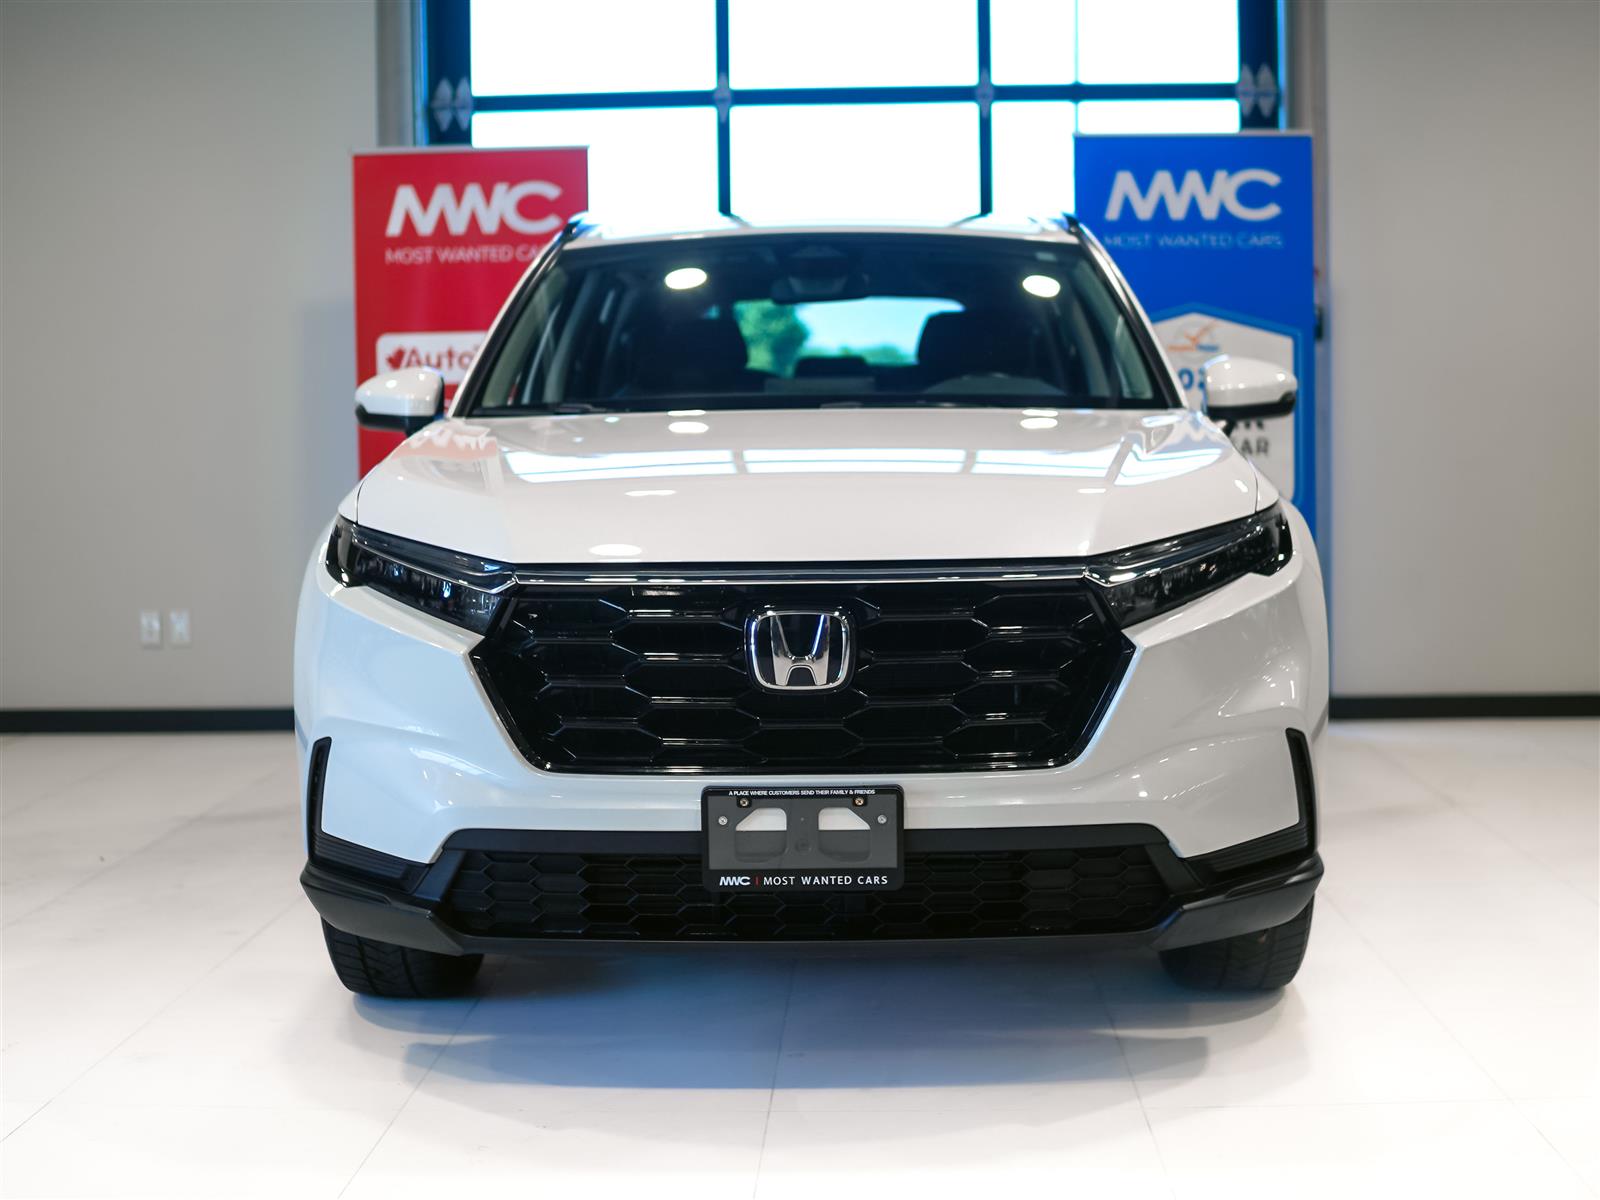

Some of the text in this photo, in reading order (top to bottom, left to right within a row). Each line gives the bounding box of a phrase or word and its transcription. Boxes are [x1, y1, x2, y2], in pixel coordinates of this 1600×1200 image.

[1105, 168, 1282, 222] MWC
[384, 180, 563, 238] MWC
[1104, 231, 1283, 249] MOST WANTED CARS
[384, 243, 544, 265] MOST WANTED CA
[405, 344, 480, 370] Auto
[719, 875, 889, 886] MWC MOST WANTED CARS
